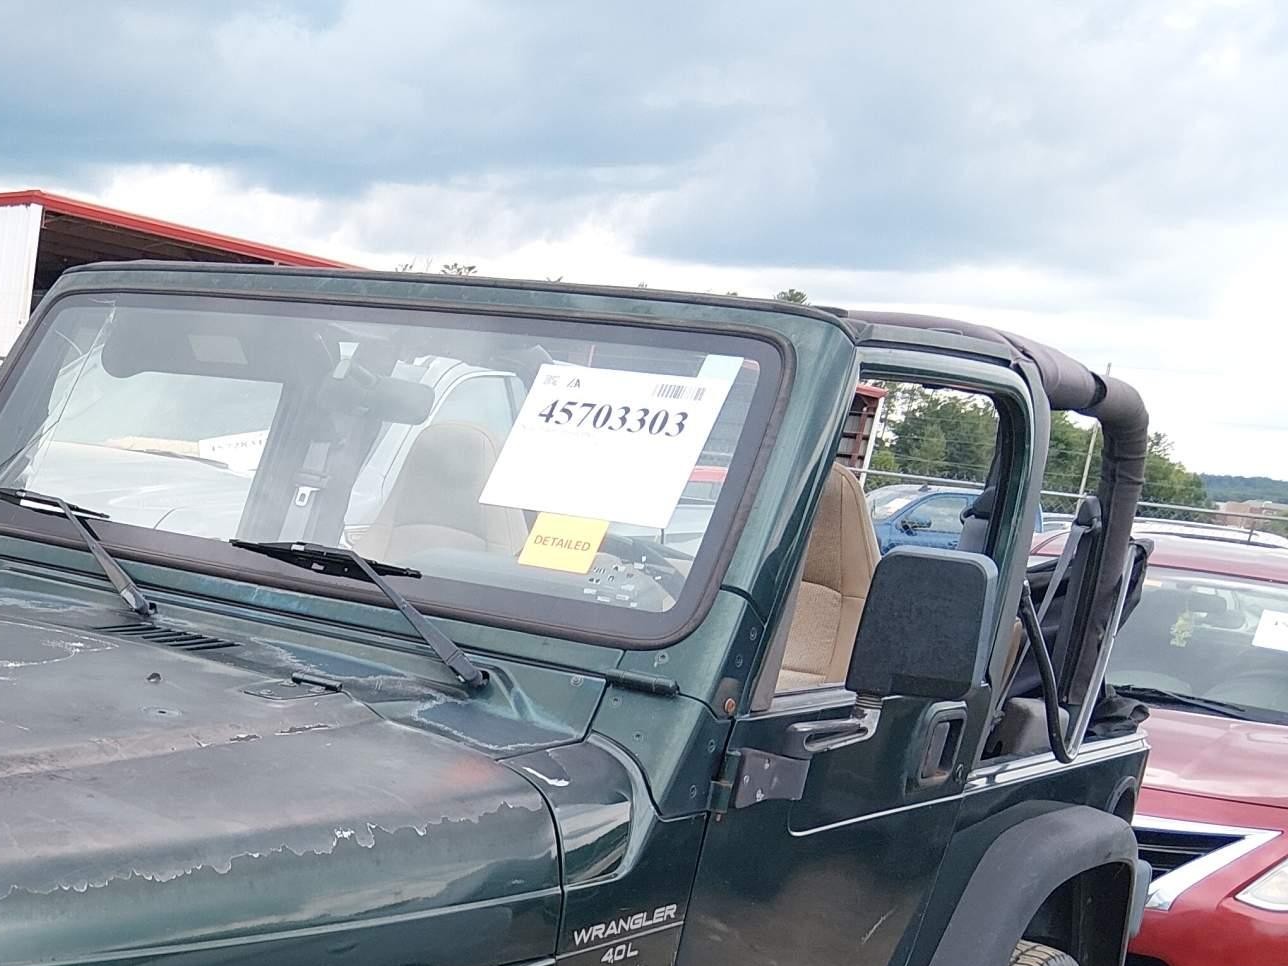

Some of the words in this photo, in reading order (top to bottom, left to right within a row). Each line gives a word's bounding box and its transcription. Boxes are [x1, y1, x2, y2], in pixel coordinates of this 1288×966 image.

[538, 399, 690, 437] 45703303
[533, 534, 591, 553] DETAILED
[573, 903, 678, 946] WRANGLER
